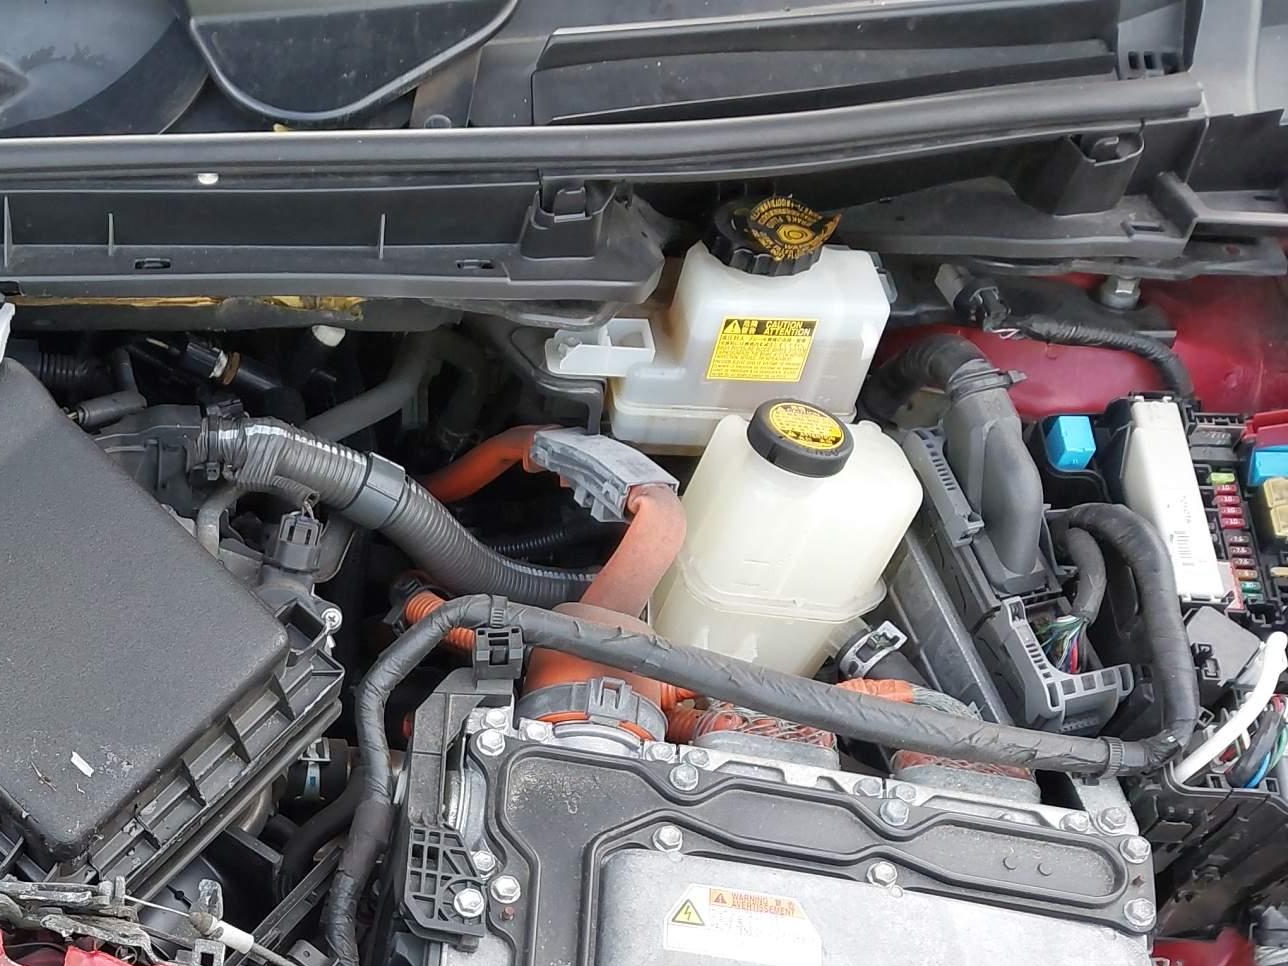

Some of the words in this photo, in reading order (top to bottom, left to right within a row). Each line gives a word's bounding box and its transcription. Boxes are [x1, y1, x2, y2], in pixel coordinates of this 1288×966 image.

[765, 320, 803, 329] CAUTION
[763, 328, 810, 336] ATTENTION
[732, 892, 768, 905] WARNING
[732, 900, 795, 917] AVERTISSEMENT
